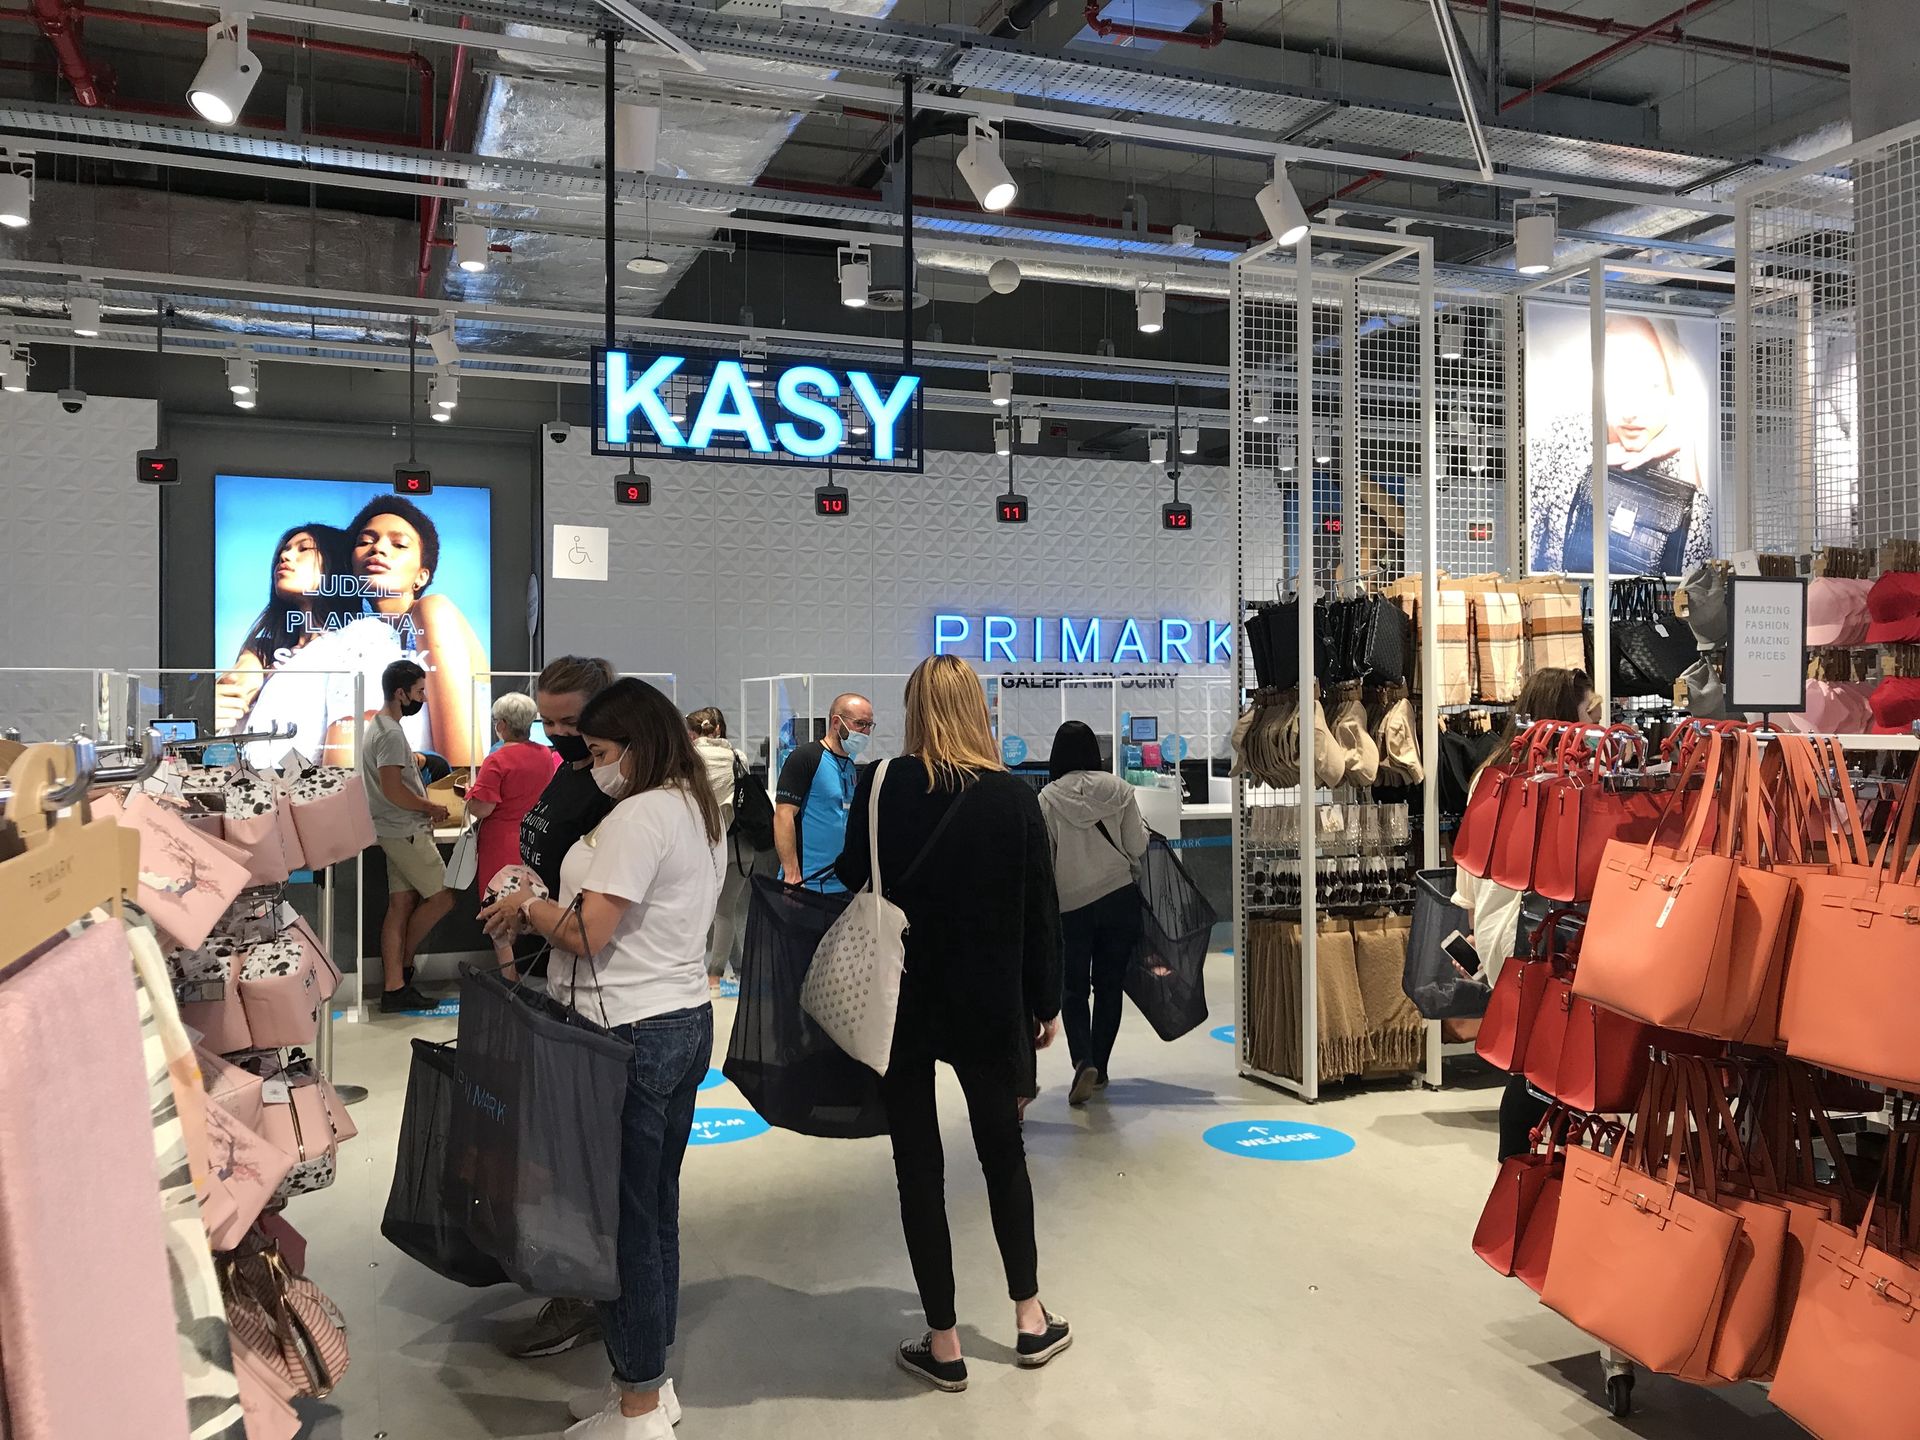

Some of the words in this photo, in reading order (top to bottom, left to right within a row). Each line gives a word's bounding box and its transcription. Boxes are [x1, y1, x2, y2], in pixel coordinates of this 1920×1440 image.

[606, 351, 920, 460] KASY
[627, 487, 639, 500] 9
[1003, 507, 1019, 519] 11
[1169, 514, 1187, 526] 12
[1744, 605, 1791, 615] AMAZING
[286, 611, 424, 635] PLANTA.
[1745, 620, 1790, 631] FASHION
[934, 615, 1231, 663] PRIMARK
[1744, 636, 1790, 646] AMAZING
[1748, 651, 1786, 661] PRICES
[1170, 839, 1201, 848] IMARK
